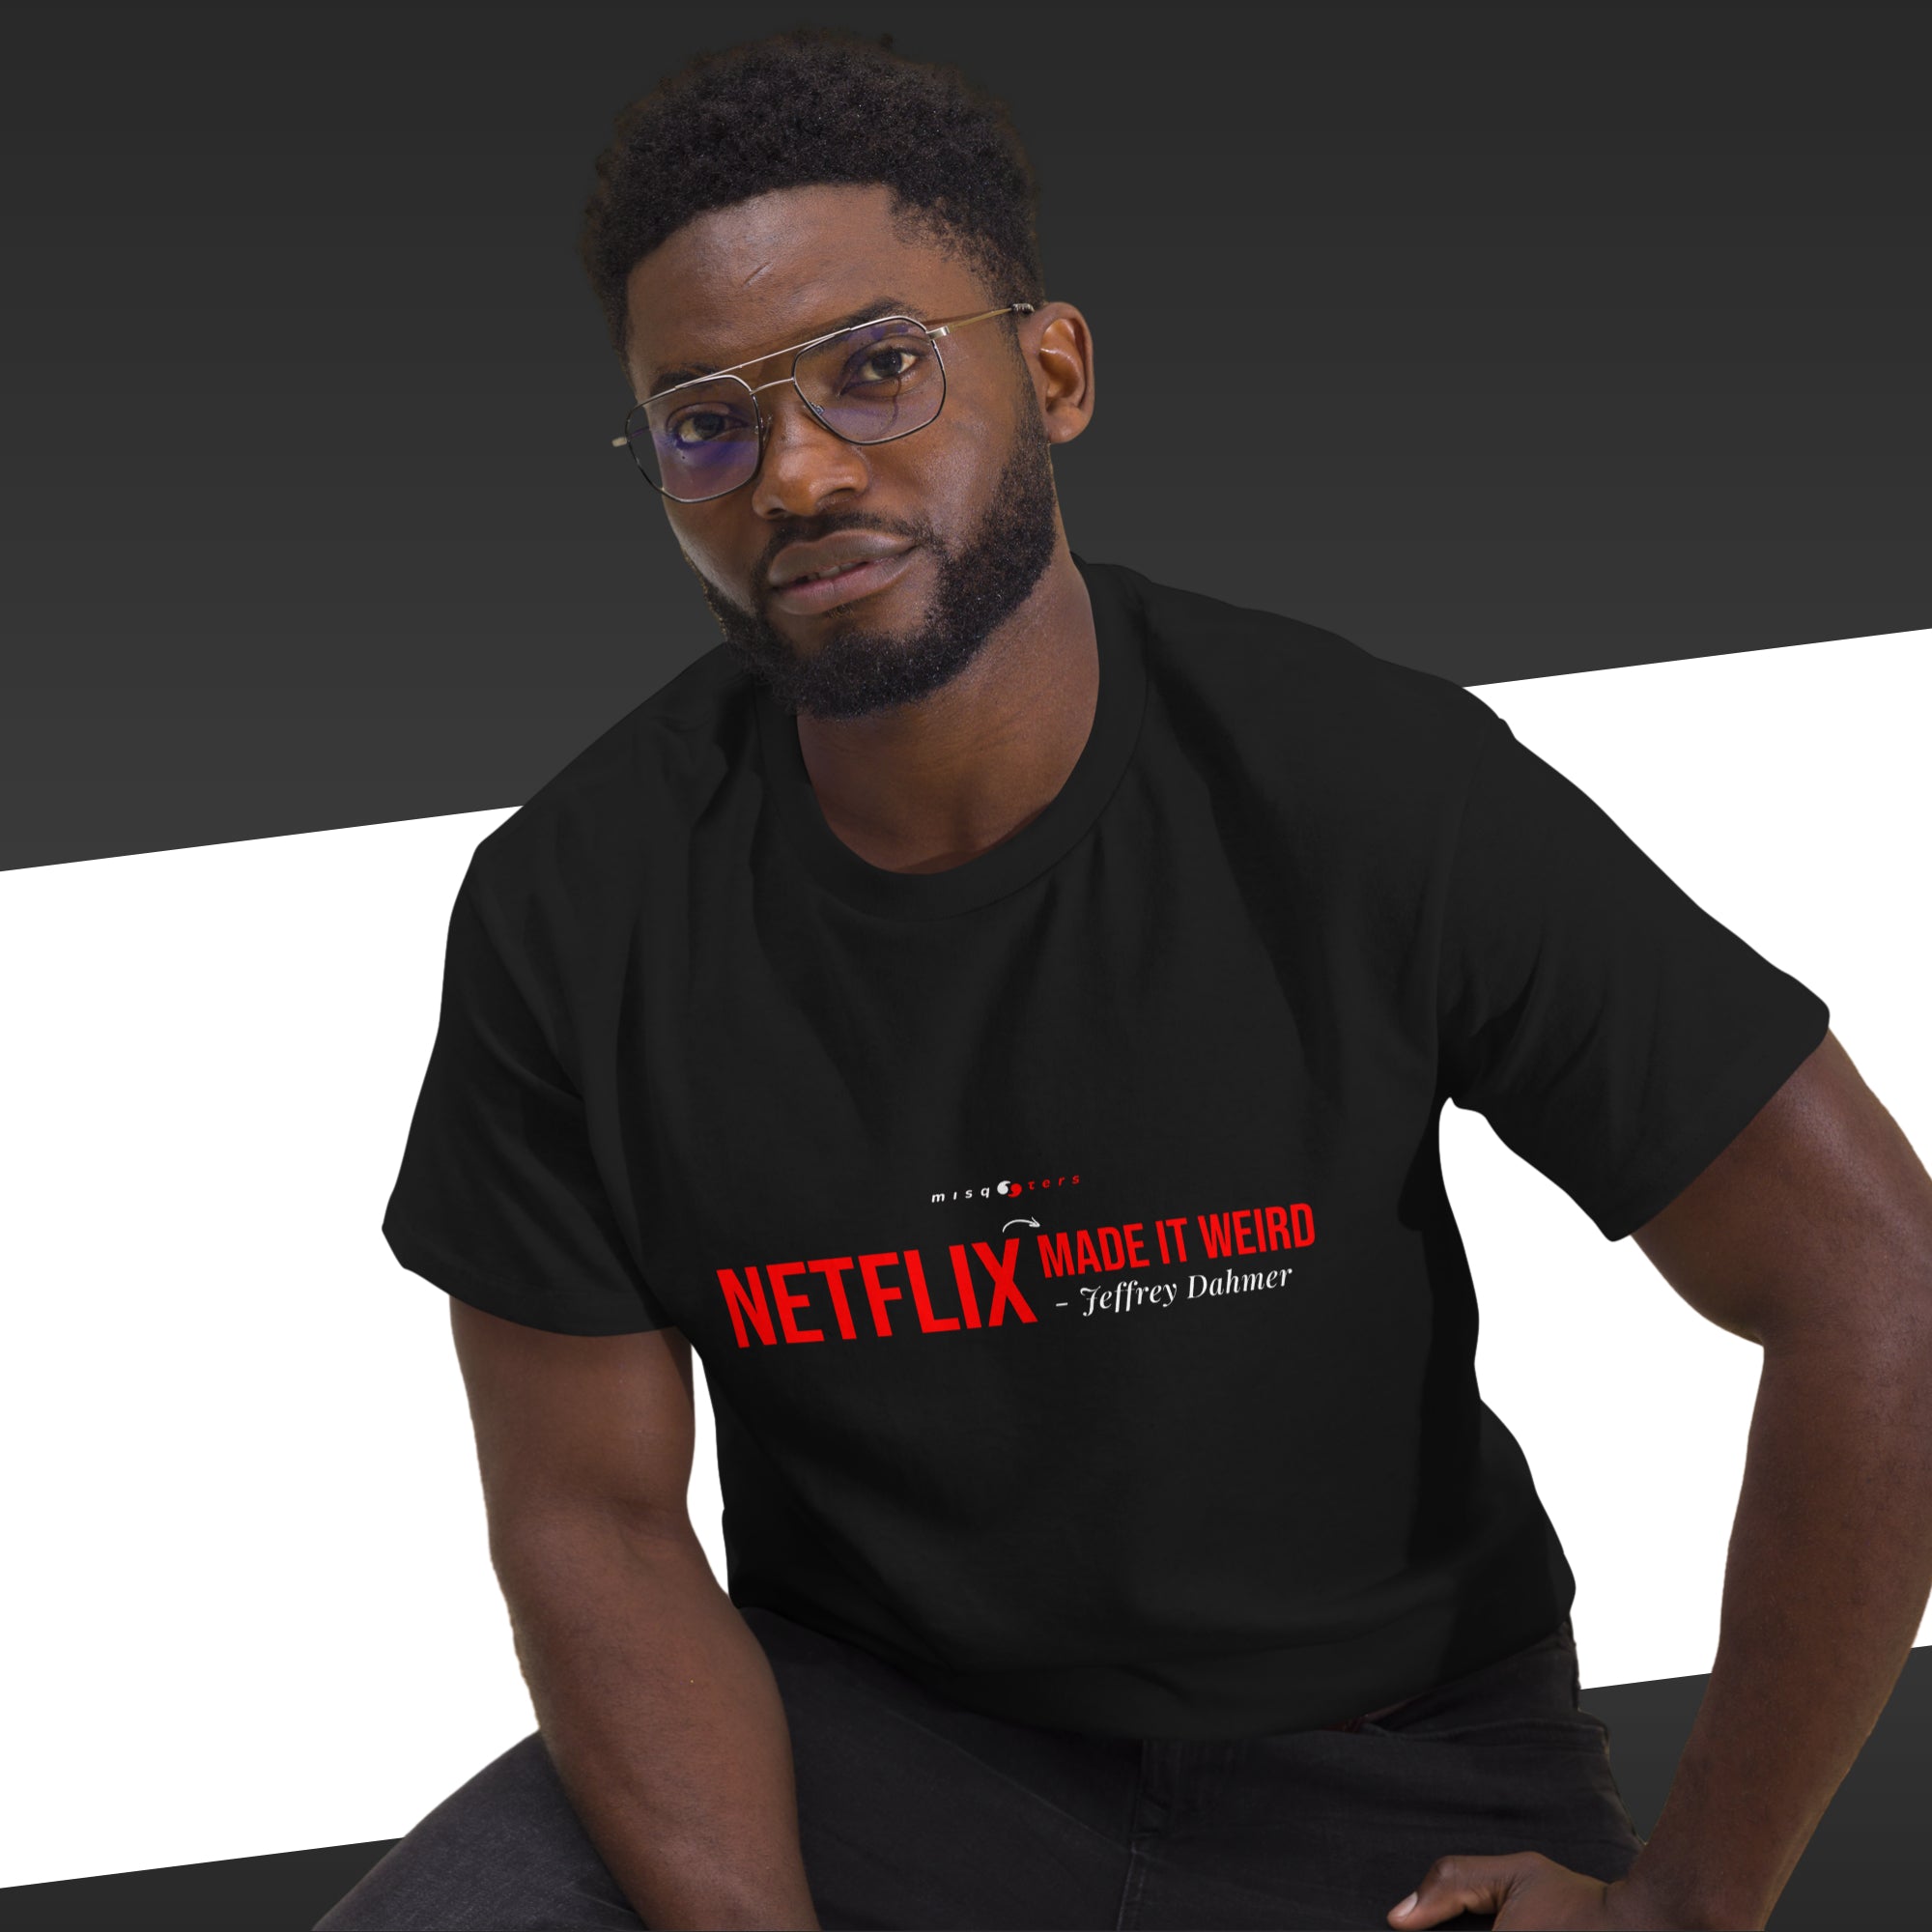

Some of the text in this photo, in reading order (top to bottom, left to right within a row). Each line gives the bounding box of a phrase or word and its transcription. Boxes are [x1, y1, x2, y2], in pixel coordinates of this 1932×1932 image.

[716, 1202, 1316, 1349] NETFLIX MADE IT WEIRD
[1079, 1279, 1178, 1318] Jeffrey
[1186, 1267, 1293, 1299] Dahmer
